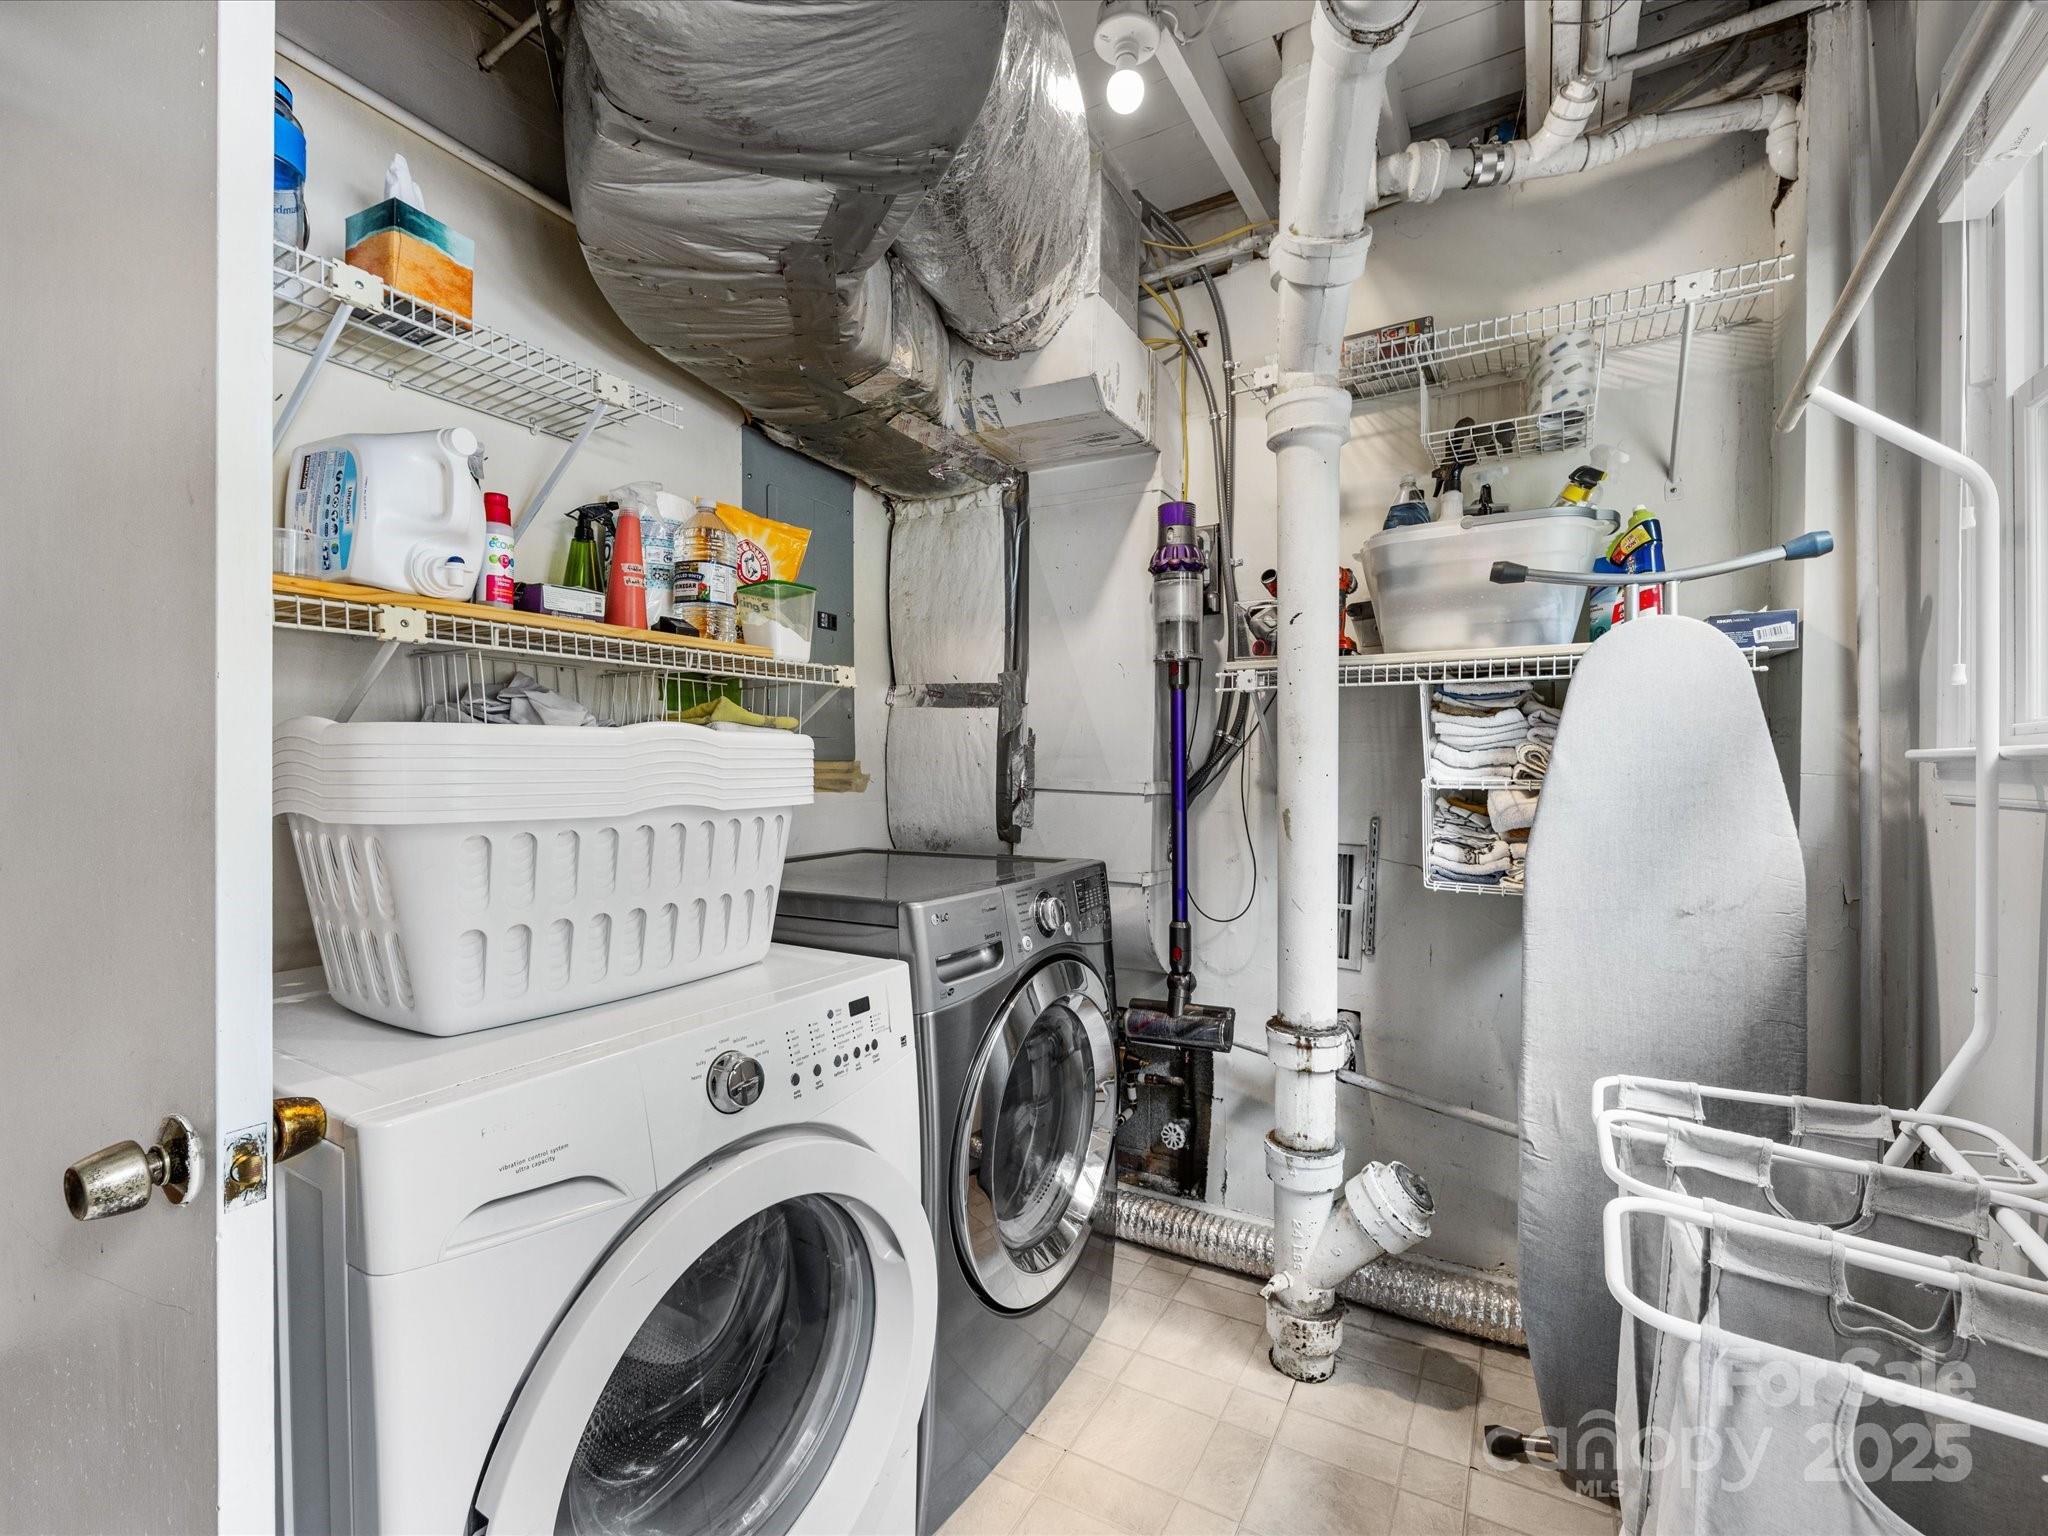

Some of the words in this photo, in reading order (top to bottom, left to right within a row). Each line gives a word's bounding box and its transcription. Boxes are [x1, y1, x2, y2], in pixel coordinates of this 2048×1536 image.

[345, 486, 353, 525] UltraClean
[489, 539, 514, 551] ecove
[675, 582, 697, 590] VINEGAR
[498, 1158, 526, 1172] vibration
[527, 1149, 549, 1162] control
[550, 1143, 569, 1153] system
[515, 1165, 530, 1174] ultra
[531, 1155, 555, 1168] capacity
